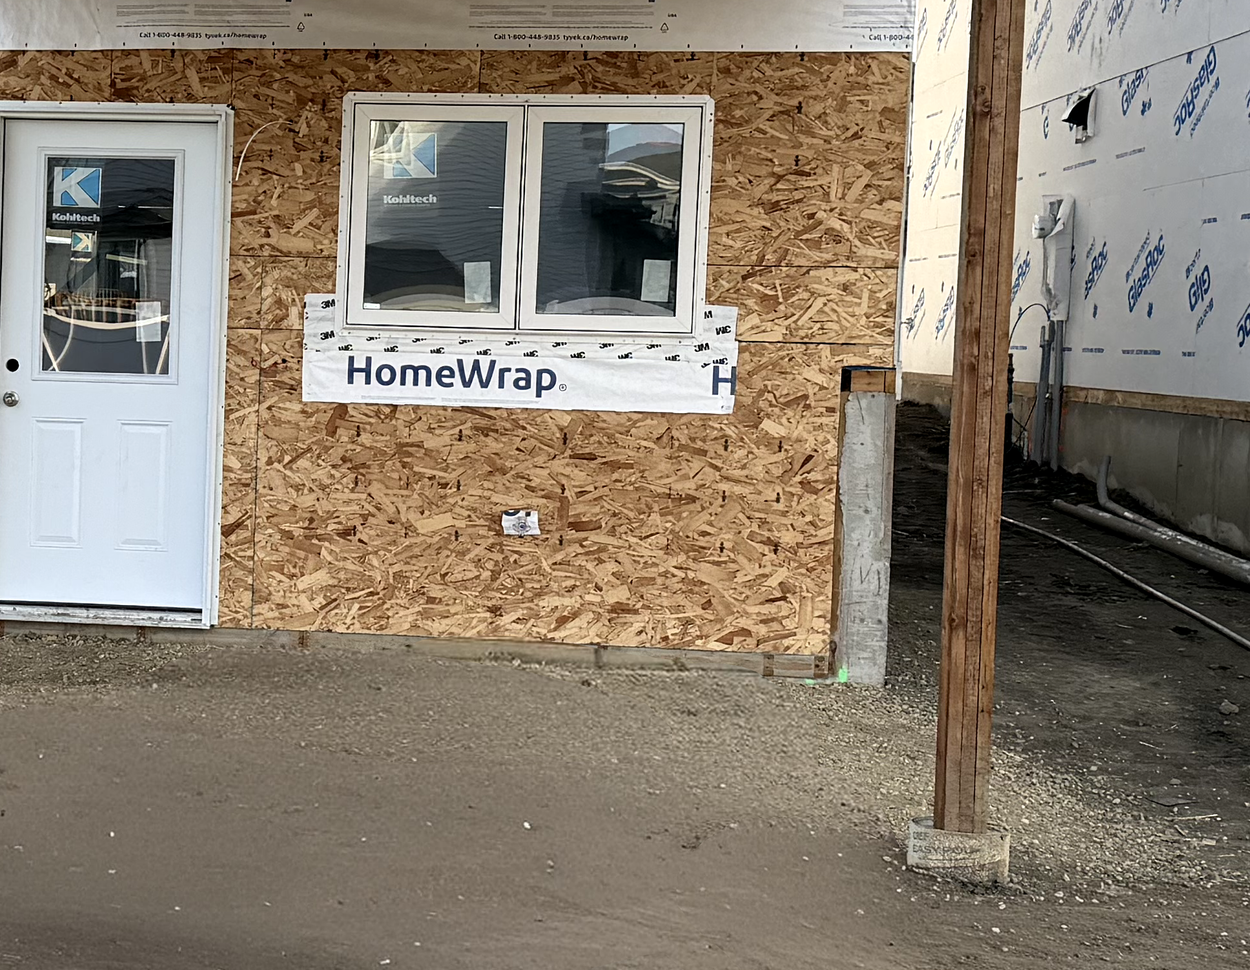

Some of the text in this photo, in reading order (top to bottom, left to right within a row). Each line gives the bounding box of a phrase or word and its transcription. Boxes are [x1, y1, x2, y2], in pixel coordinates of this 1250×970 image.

[204, 32, 268, 40] tyvek.ca/homewrap
[493, 33, 506, 41] Call
[563, 34, 629, 42] tyvek.ca/homewrap
[869, 34, 882, 42] Call
[1173, 45, 1218, 137] GlasRoc
[383, 194, 437, 205] Kohltech
[52, 212, 101, 223] Kohltech
[1128, 234, 1166, 314] GlasRoc
[321, 299, 336, 310] 3M
[320, 330, 336, 341] 3M
[715, 325, 732, 336] 3M
[347, 356, 557, 399] HomeWrap
